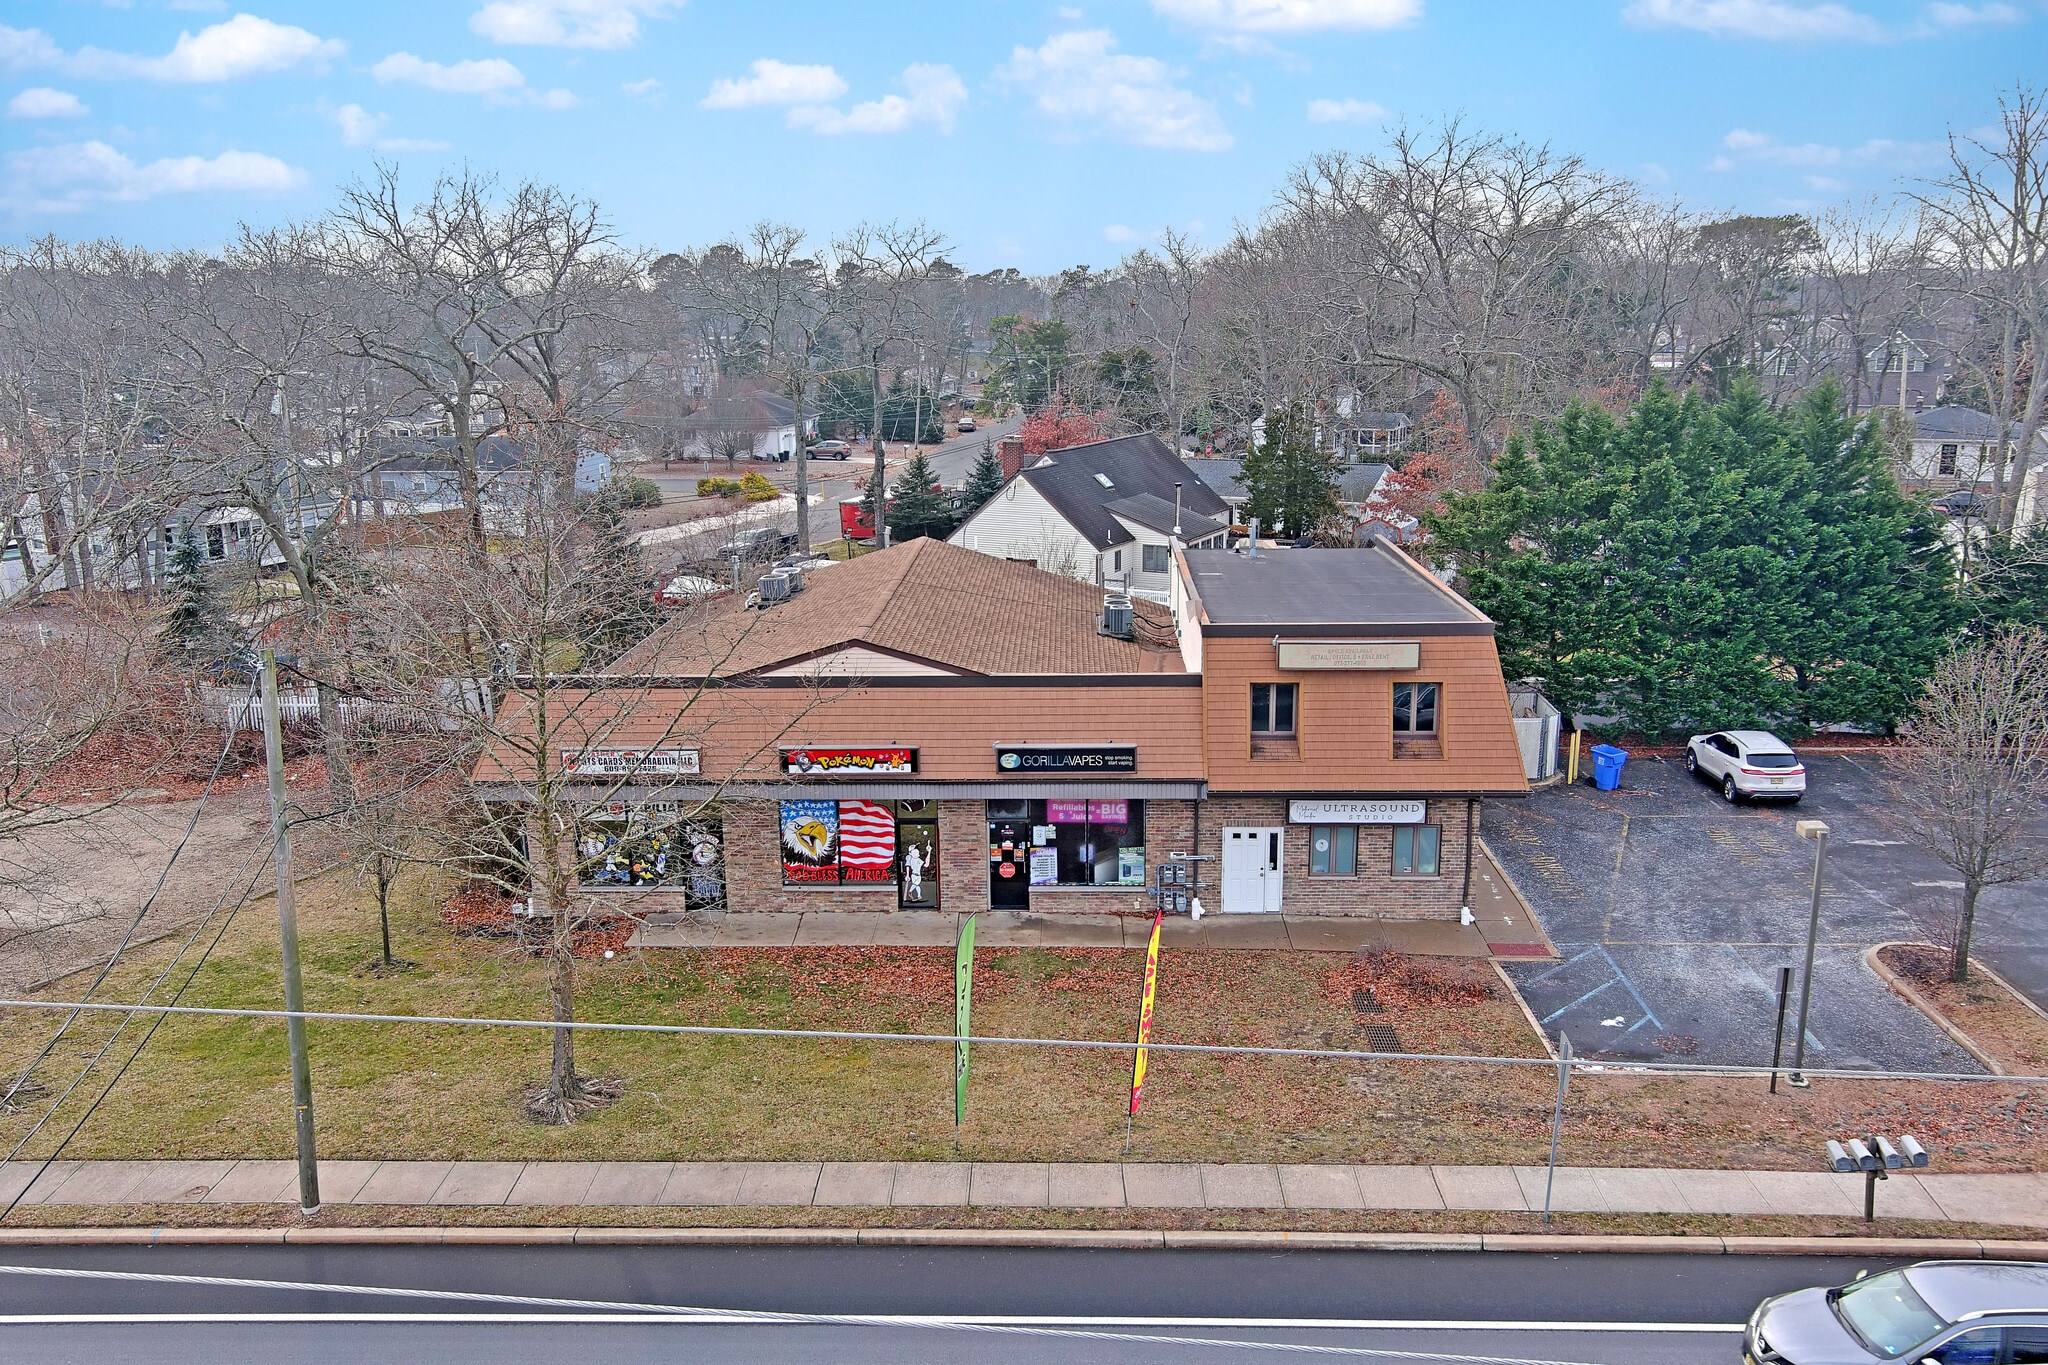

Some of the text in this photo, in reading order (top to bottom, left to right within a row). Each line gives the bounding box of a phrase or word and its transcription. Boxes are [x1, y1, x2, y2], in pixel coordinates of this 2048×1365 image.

[599, 757, 623, 766] CARDS
[1101, 803, 1126, 814] BIG
[1323, 804, 1420, 813] ULTRASOUND
[811, 869, 839, 882] BLESS
[846, 867, 890, 881] AMERICA
